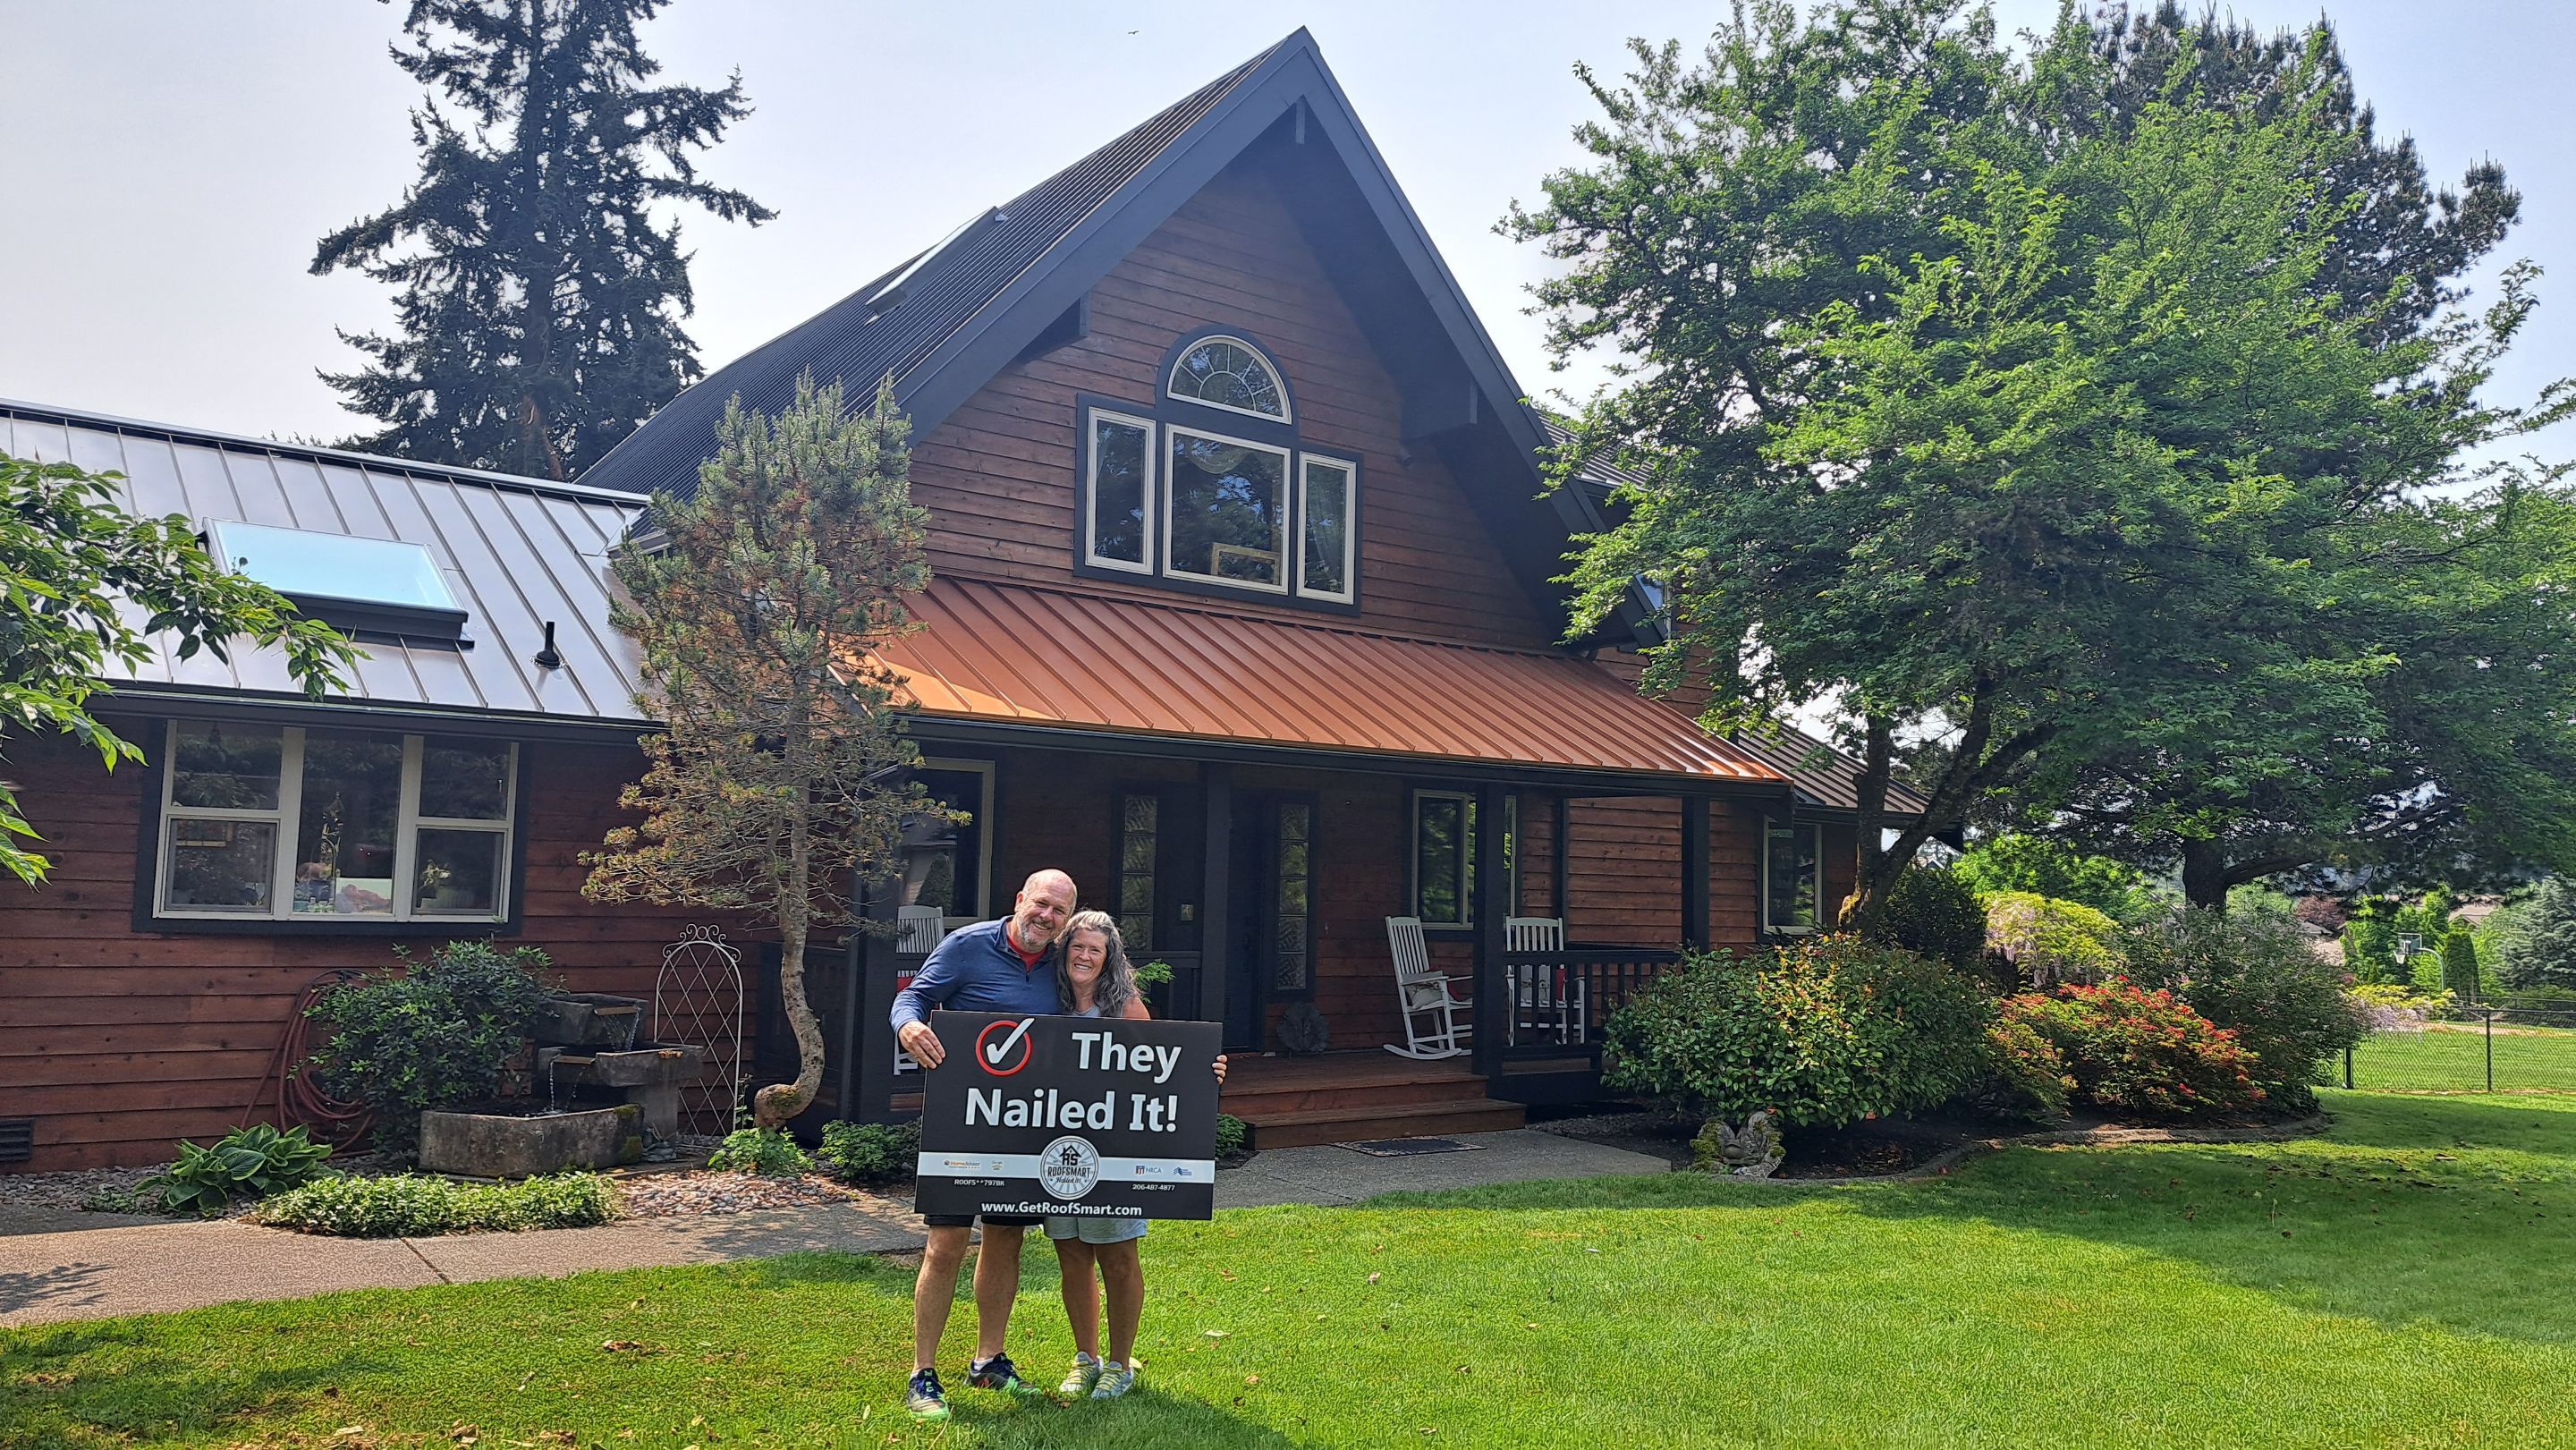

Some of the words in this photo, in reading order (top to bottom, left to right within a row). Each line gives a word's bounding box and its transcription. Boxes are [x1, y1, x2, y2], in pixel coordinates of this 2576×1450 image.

[1072, 1031, 1182, 1084] They
[965, 1088, 1115, 1131] Nailed
[1129, 1094, 1179, 1132] It!
[1062, 1153, 1079, 1166] RS
[1047, 1166, 1091, 1178] ROOFSMART
[981, 1200, 1142, 1217] www.GetRoofSmart.com
